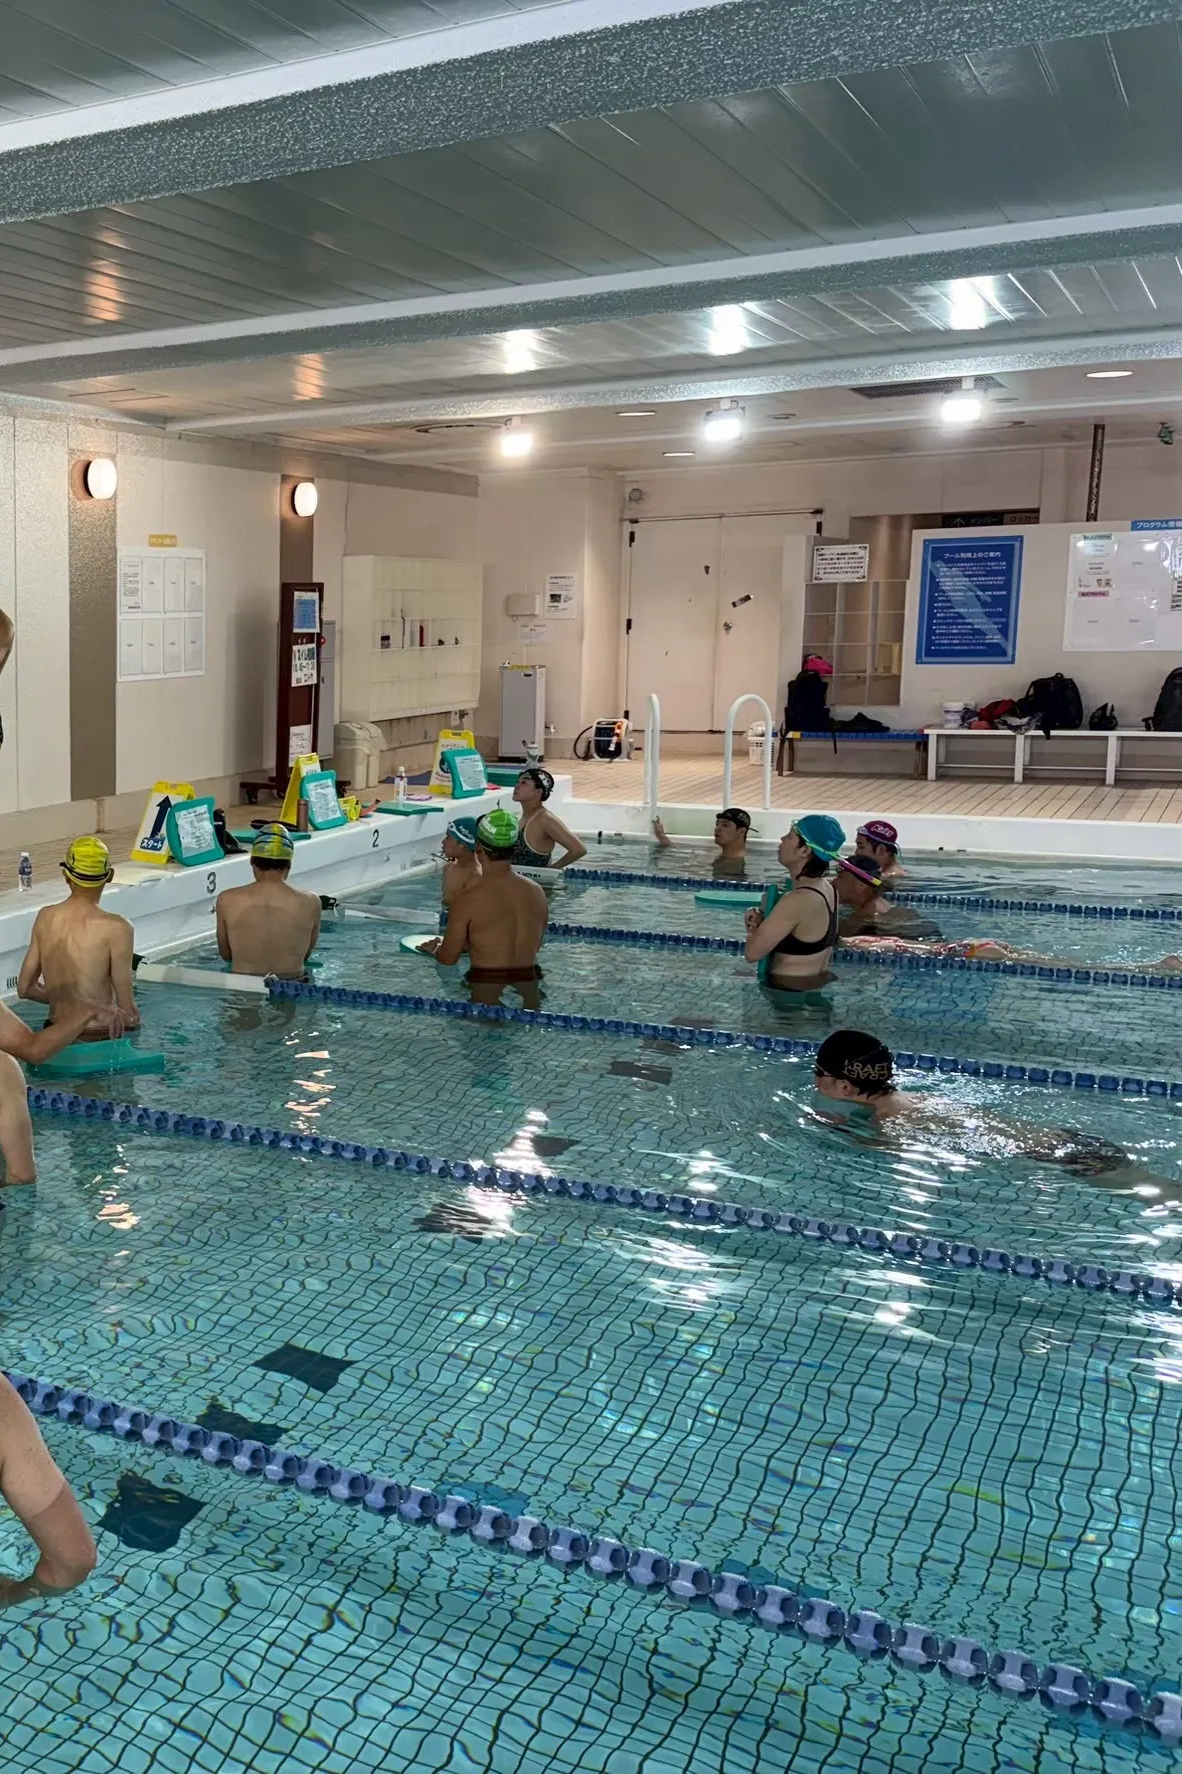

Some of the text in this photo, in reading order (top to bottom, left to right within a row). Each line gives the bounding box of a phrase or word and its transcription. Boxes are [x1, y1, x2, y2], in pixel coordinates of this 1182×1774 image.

[141, 838, 162, 849] スタート
[372, 829, 379, 848] 2
[206, 871, 217, 894] 3
